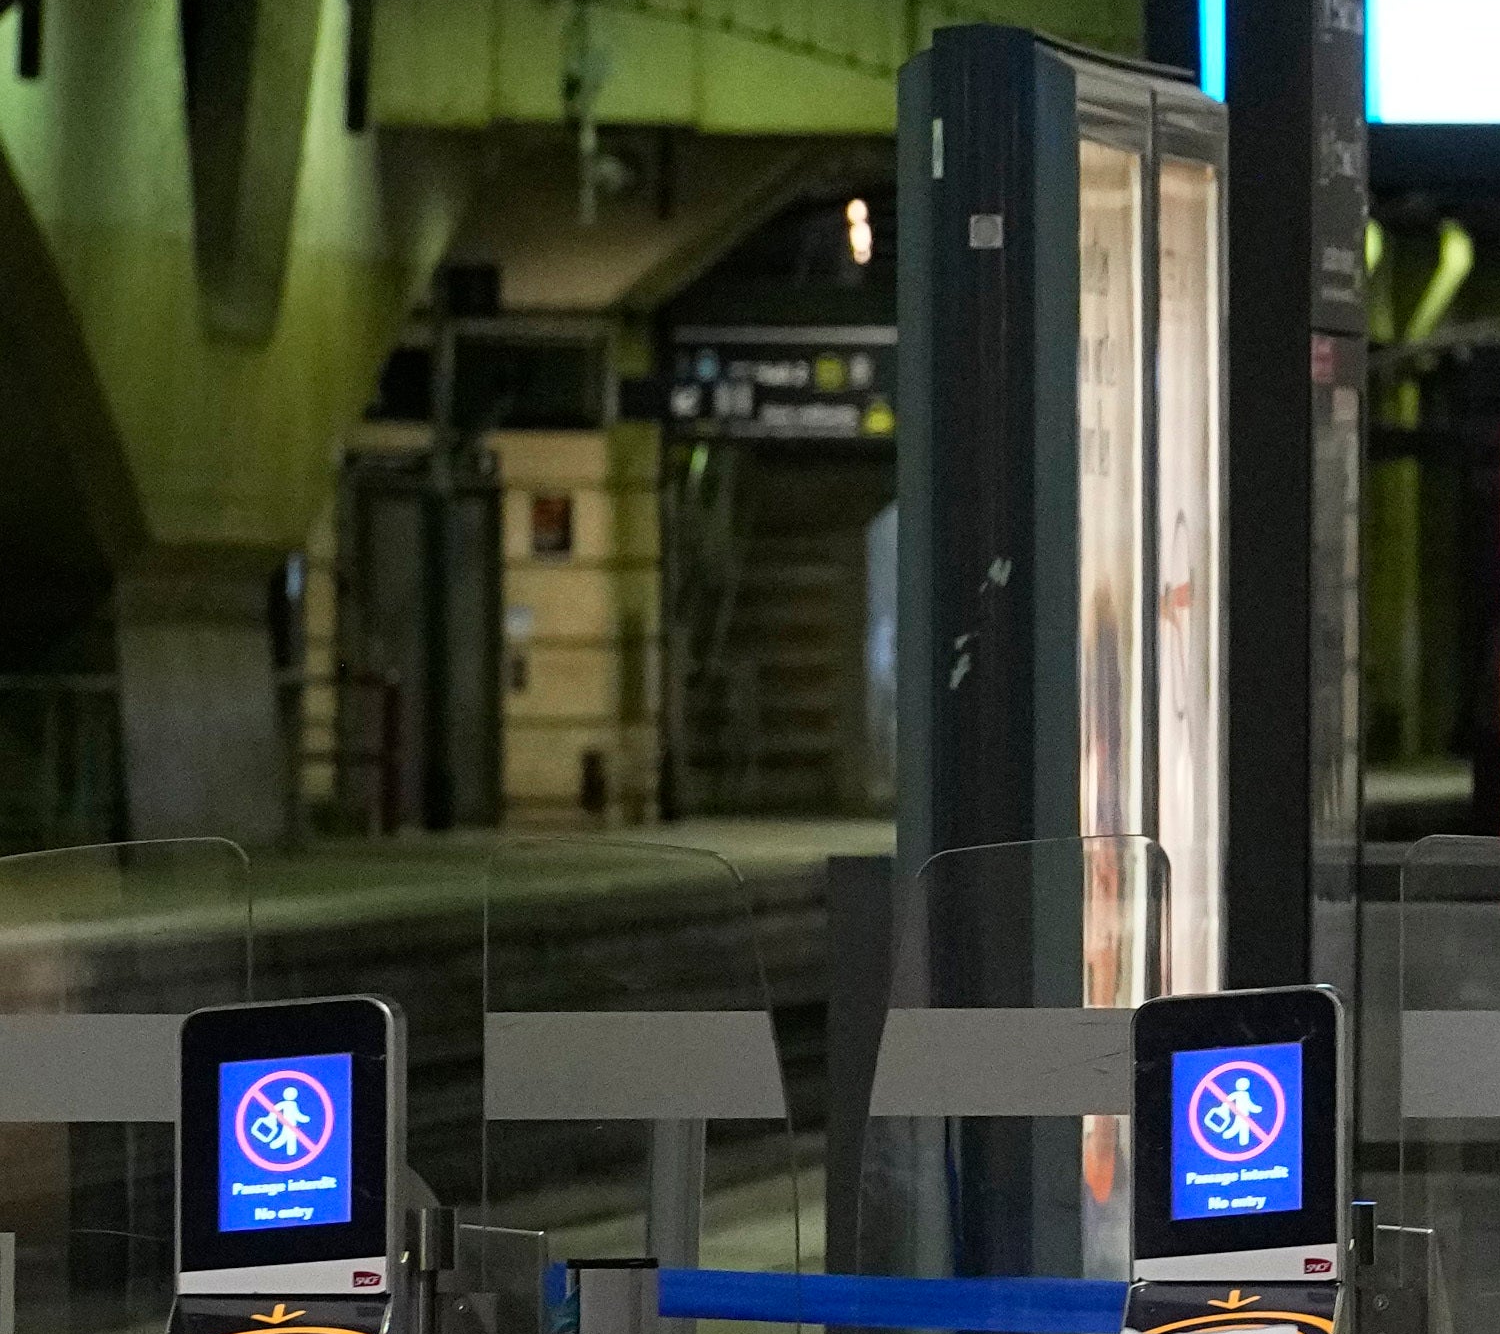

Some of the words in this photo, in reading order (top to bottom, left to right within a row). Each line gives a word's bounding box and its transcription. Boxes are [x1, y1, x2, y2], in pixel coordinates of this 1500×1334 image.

[1185, 1171, 1240, 1186] Passage
[1240, 1165, 1289, 1181] interdit
[233, 1182, 287, 1196] Passage
[287, 1176, 337, 1192] interdit
[1207, 1196, 1230, 1210] No
[1230, 1195, 1267, 1210] entry
[254, 1207, 277, 1221] No
[277, 1207, 314, 1221] entry
